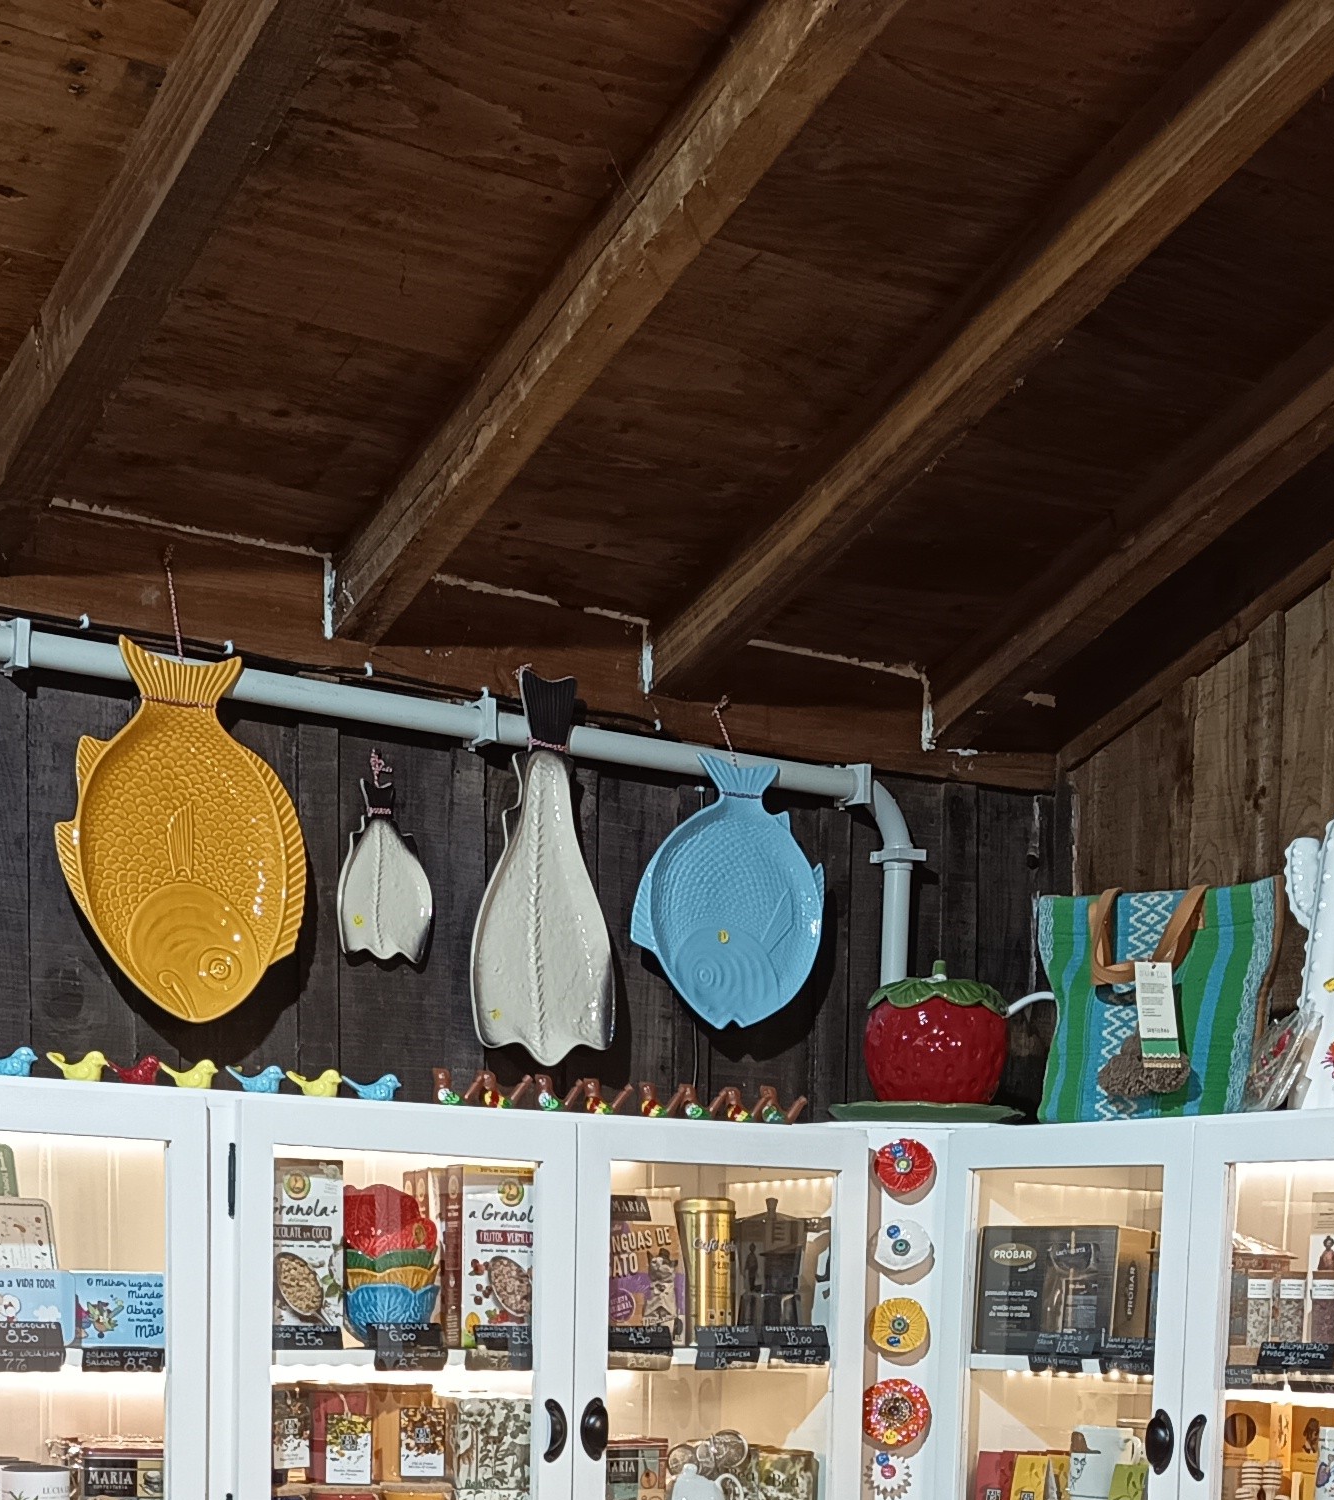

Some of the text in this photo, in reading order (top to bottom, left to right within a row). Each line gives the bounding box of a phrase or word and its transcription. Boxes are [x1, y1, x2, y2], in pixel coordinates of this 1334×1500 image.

[656, 1227, 672, 1245] DE
[5, 1330, 38, 1343] 8.50
[135, 1324, 164, 1338] Mãe
[389, 1330, 416, 1342] 6.00
[124, 1358, 153, 1371] 8.50
[88, 1471, 133, 1485] MARIA
